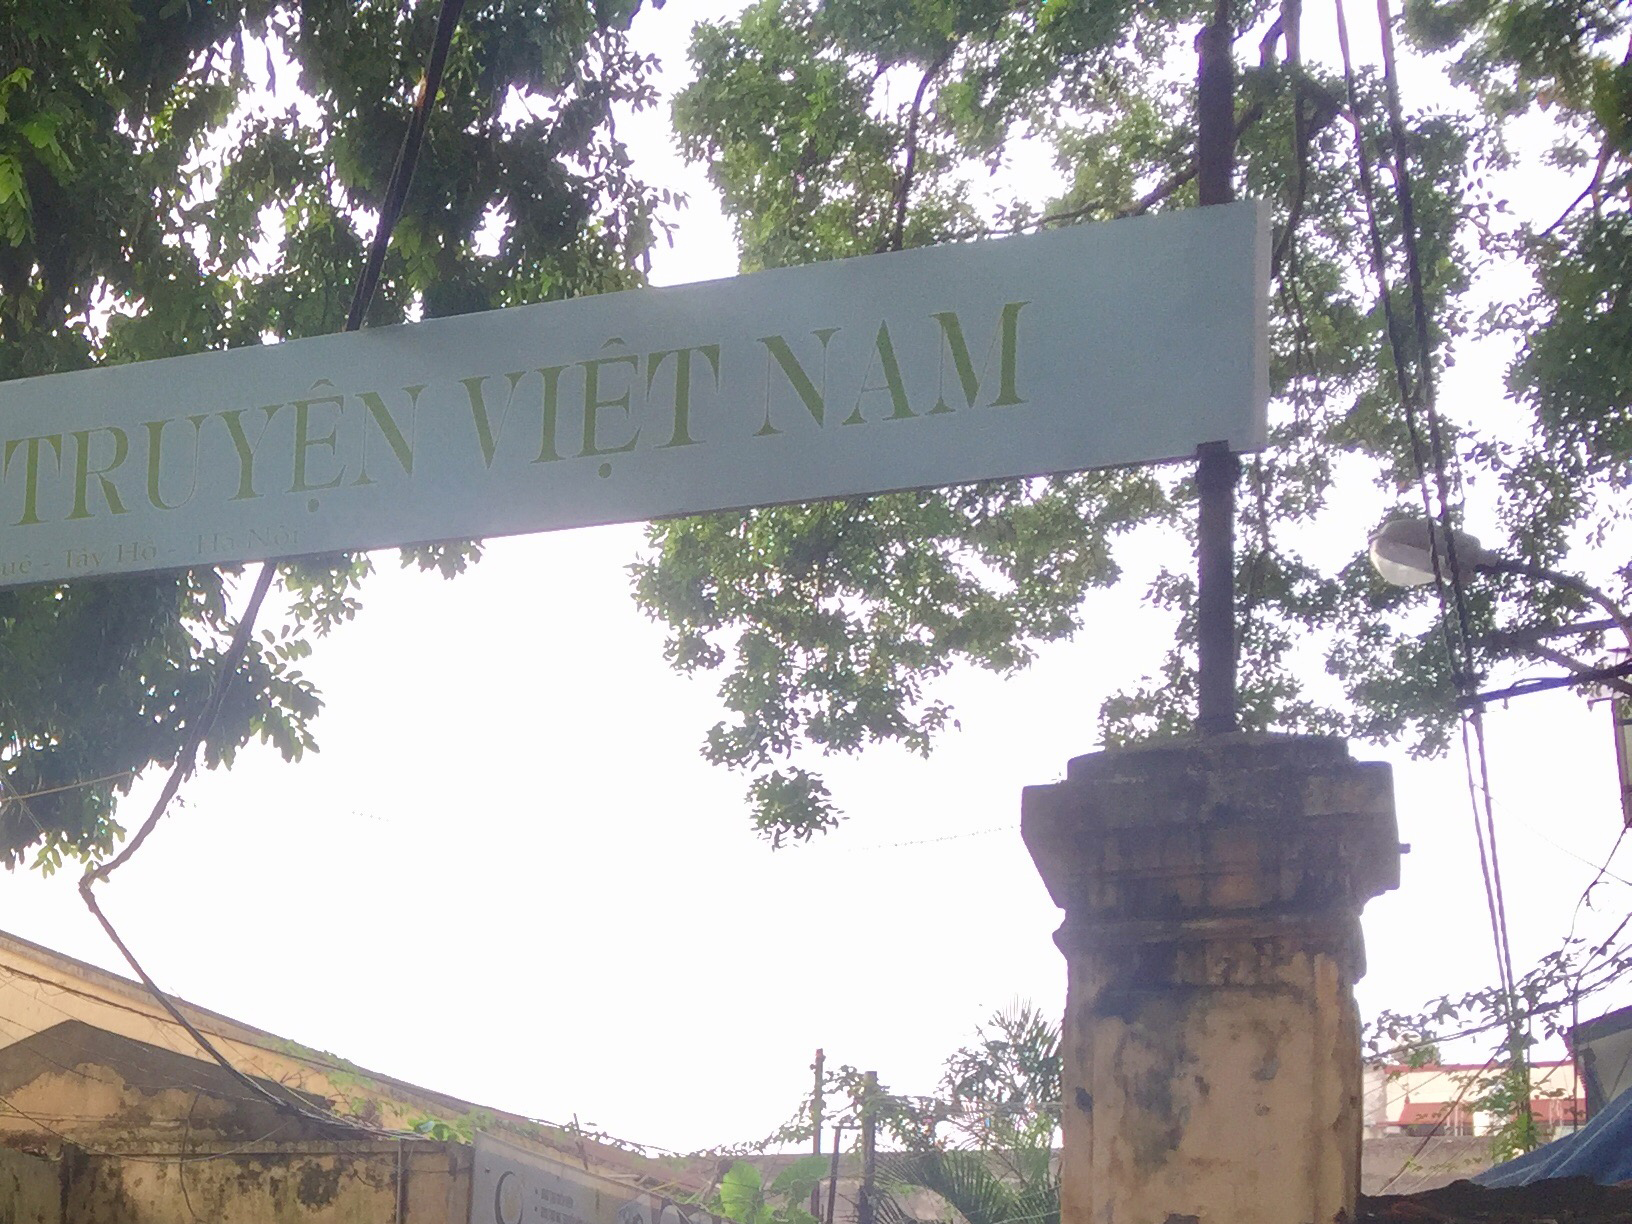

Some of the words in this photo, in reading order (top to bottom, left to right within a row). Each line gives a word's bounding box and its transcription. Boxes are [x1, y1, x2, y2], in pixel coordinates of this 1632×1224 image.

[2, 378, 427, 526] TRUYỆN
[460, 337, 722, 479] VIỆT
[752, 300, 1032, 436] NAM
